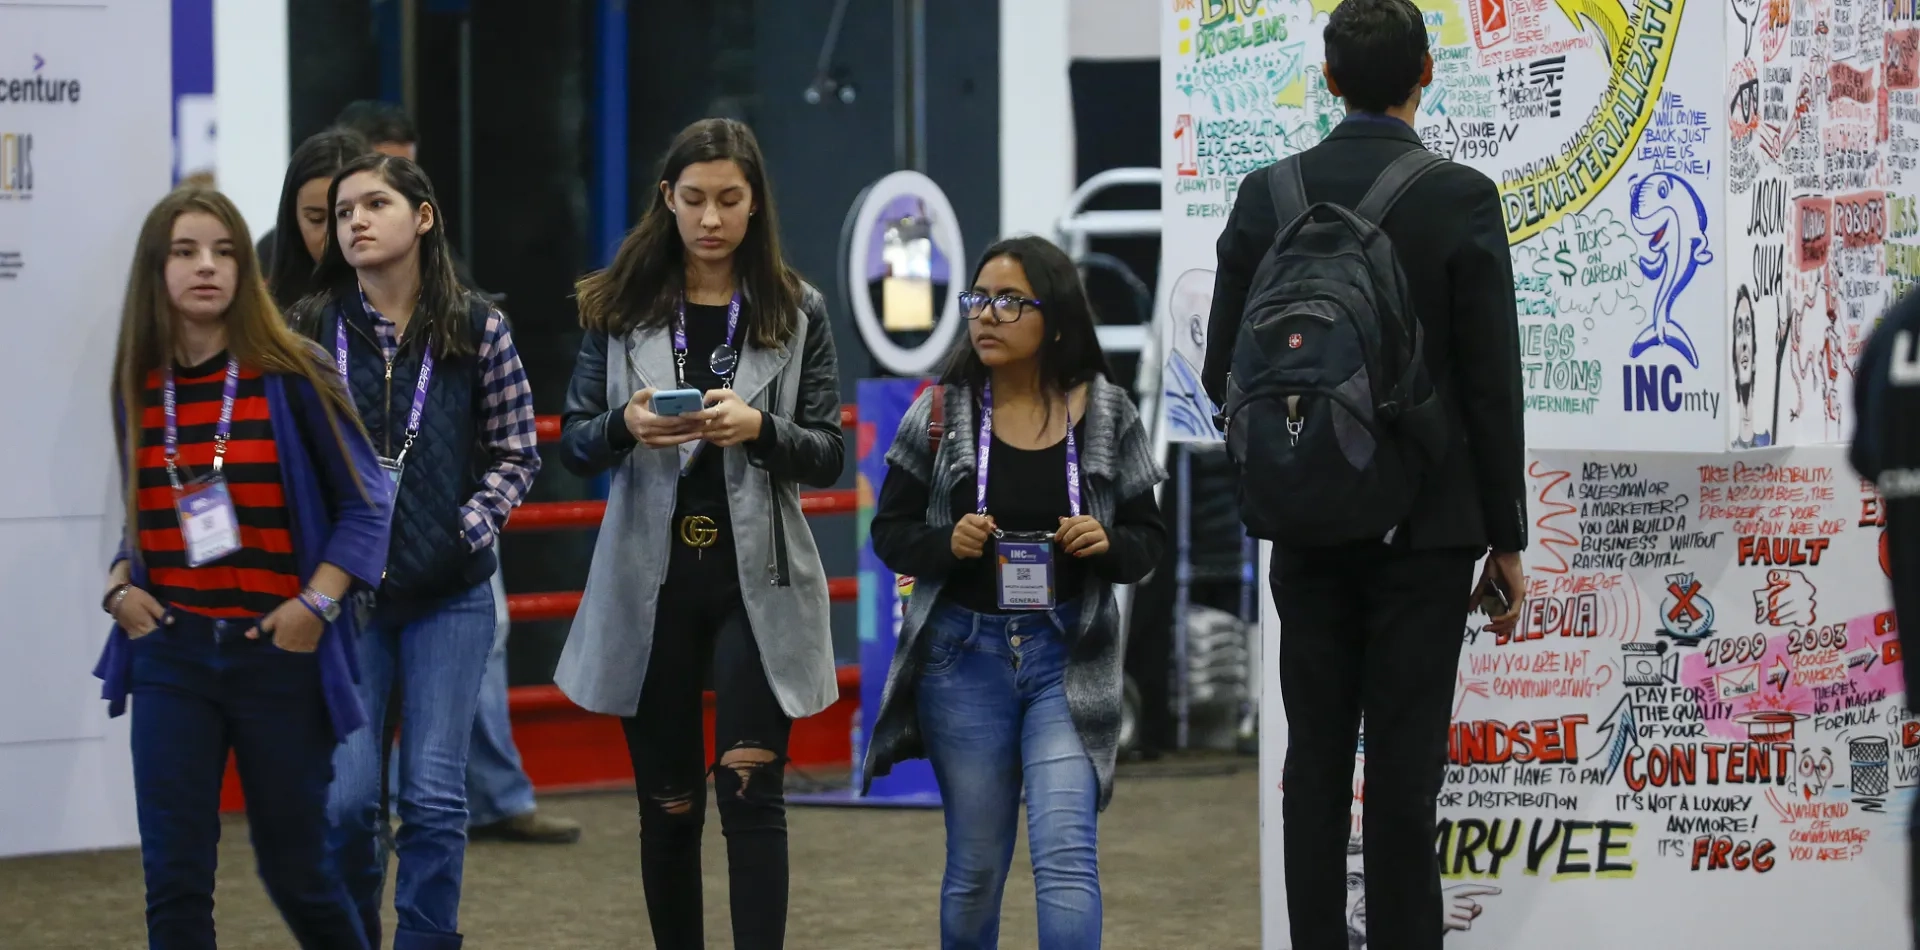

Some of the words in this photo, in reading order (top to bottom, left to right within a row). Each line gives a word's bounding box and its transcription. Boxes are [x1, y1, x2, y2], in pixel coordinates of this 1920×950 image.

[1196, 14, 1288, 62] PROBLEMS
[0, 74, 81, 103] centure
[1661, 91, 1684, 109] WE
[1653, 110, 1673, 126] WILL
[1676, 109, 1707, 126] COME
[1460, 122, 1496, 138] SINCE
[1460, 140, 1498, 160] 1990
[1502, 153, 1560, 189] PHYSICAL
[1560, 105, 1604, 162] SHARES
[1637, 146, 1677, 161] LEAVE
[1680, 144, 1695, 159] US
[1653, 158, 1711, 180] ALONE!
[1747, 177, 1787, 237] JASON
[1835, 198, 1884, 240] ROBOTS
[1574, 226, 1612, 253] TASKS
[1581, 261, 1628, 287] CARBON
[1753, 243, 1784, 302] SILVA
[729, 301, 740, 328] telcel
[338, 348, 347, 375] telcel
[417, 364, 431, 393] telcel
[1522, 359, 1602, 395] TIONS
[220, 394, 234, 423] telcel
[1068, 462, 1079, 486] telcel
[1583, 462, 1609, 481] ARE
[1611, 463, 1637, 478] YOU
[1697, 464, 1729, 484] TAKE
[1567, 483, 1575, 499] A
[1579, 479, 1647, 499] SALESMAN
[1648, 481, 1669, 494] OR
[1700, 485, 1721, 501] BE
[1580, 504, 1589, 518] A
[1591, 494, 1689, 517] MARKETER?
[1790, 504, 1821, 520] YOUR
[1579, 521, 1601, 535] YOU
[1605, 519, 1630, 535] CAN
[1632, 517, 1674, 534] BUILD
[1676, 515, 1686, 532] A
[1787, 521, 1814, 535] ARE
[1581, 535, 1659, 552] BUSINESS
[1738, 536, 1830, 567] FAULT
[1572, 552, 1628, 570] RAISING
[1629, 550, 1685, 569] CAPITAL
[1603, 574, 1623, 592] OF
[1704, 632, 1767, 668] 1999
[1787, 623, 1847, 655] 2003
[1469, 653, 1501, 676] WHY
[1503, 651, 1530, 675] YOU
[1532, 651, 1560, 673] ARE
[1565, 650, 1591, 676] NOT
[1635, 687, 1667, 703] PAY
[1670, 686, 1706, 703] FOR
[1814, 702, 1829, 715] NO
[1833, 700, 1842, 714] A
[1845, 688, 1887, 709] MAGICAL
[1633, 703, 1668, 722] THE
[1672, 703, 1733, 722] QUALITY
[1448, 714, 1589, 767] INDSET
[1639, 724, 1660, 738] OF
[1660, 723, 1708, 738] YOUR
[1514, 763, 1552, 786] HAVE
[1560, 767, 1576, 784] TO
[1580, 767, 1609, 785] PAY
[1624, 743, 1795, 792] CONTENT
[1468, 790, 1577, 809] DISTRIBUTION
[1616, 794, 1644, 811] IT'S
[1648, 793, 1677, 813] NOT
[1680, 793, 1688, 811] A
[1693, 795, 1752, 813] LUXURY
[1435, 817, 1522, 878] ARY
[1658, 838, 1685, 857] IT'S
[1789, 846, 1813, 861] YOU
